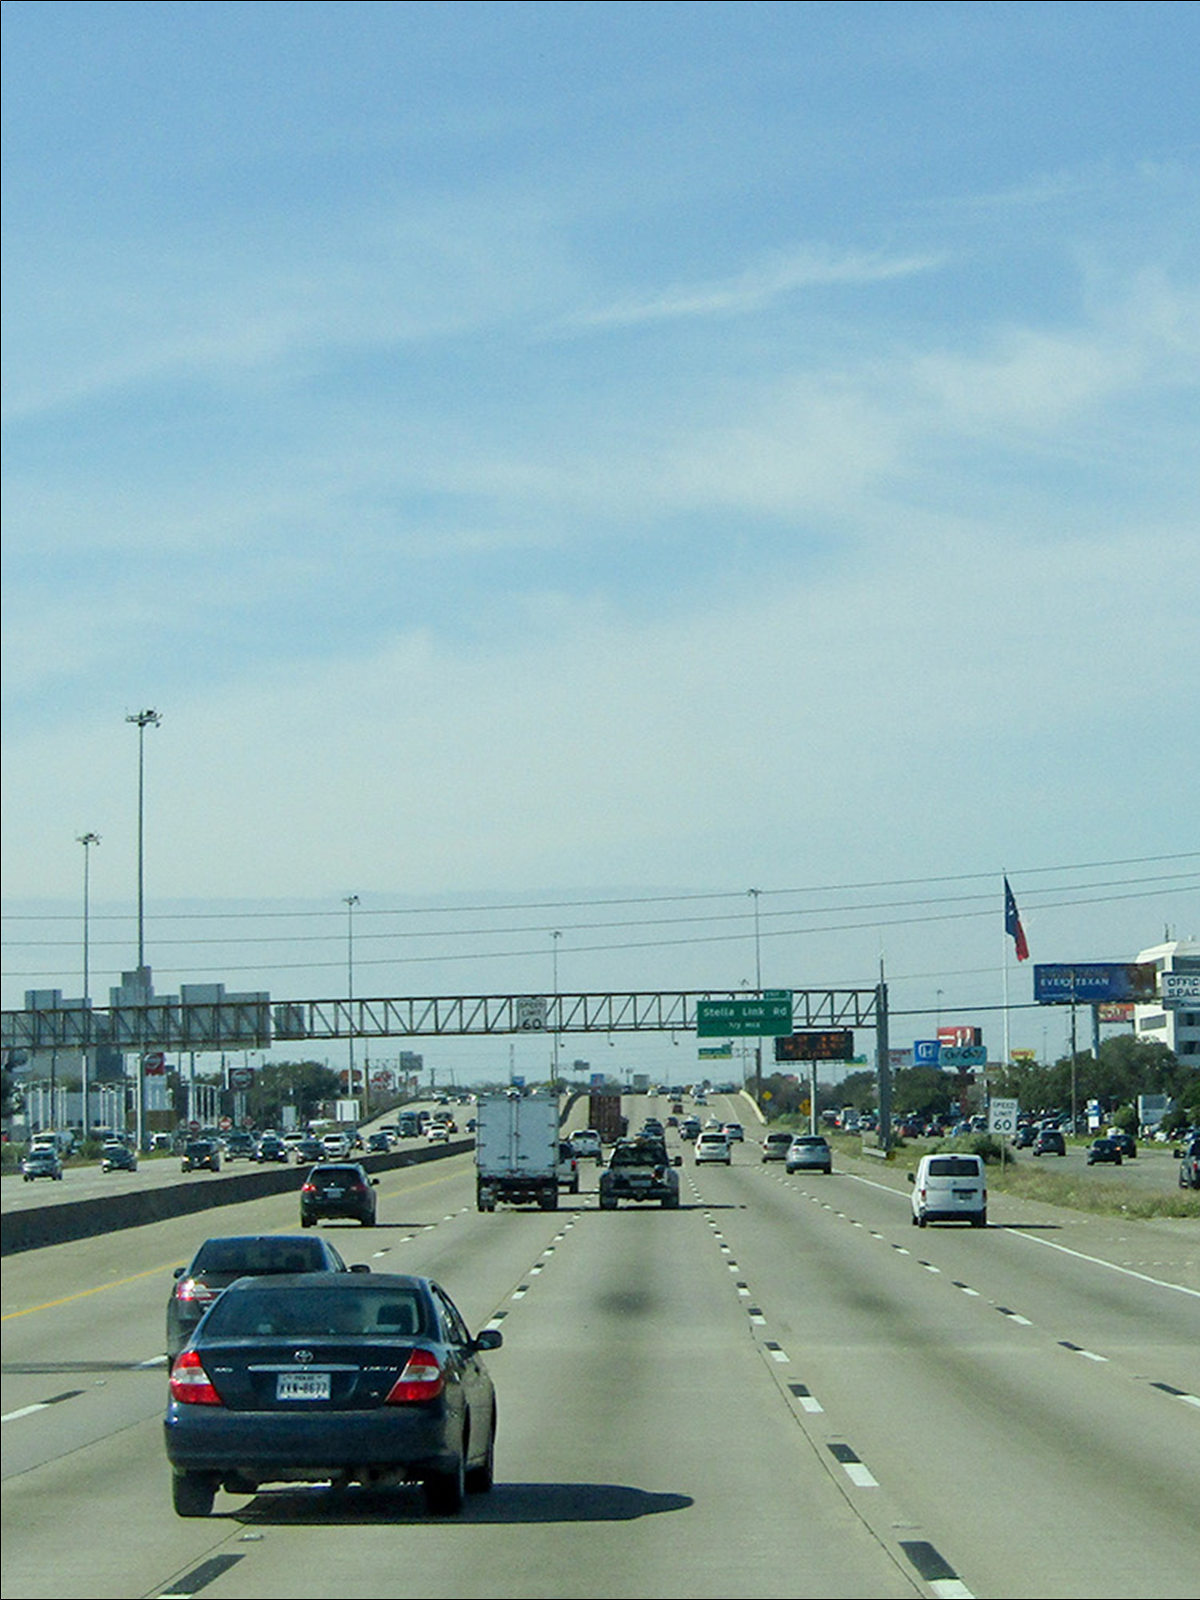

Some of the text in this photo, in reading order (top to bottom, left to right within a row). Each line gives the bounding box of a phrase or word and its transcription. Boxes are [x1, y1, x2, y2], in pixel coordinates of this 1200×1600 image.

[1076, 978, 1110, 986] TEXAN
[703, 1006, 788, 1017] Stella Link Rd
[522, 1018, 542, 1030] 60
[993, 1101, 1015, 1109] SPEED
[994, 1110, 1012, 1118] LIMIT
[994, 1119, 1012, 1131] 60
